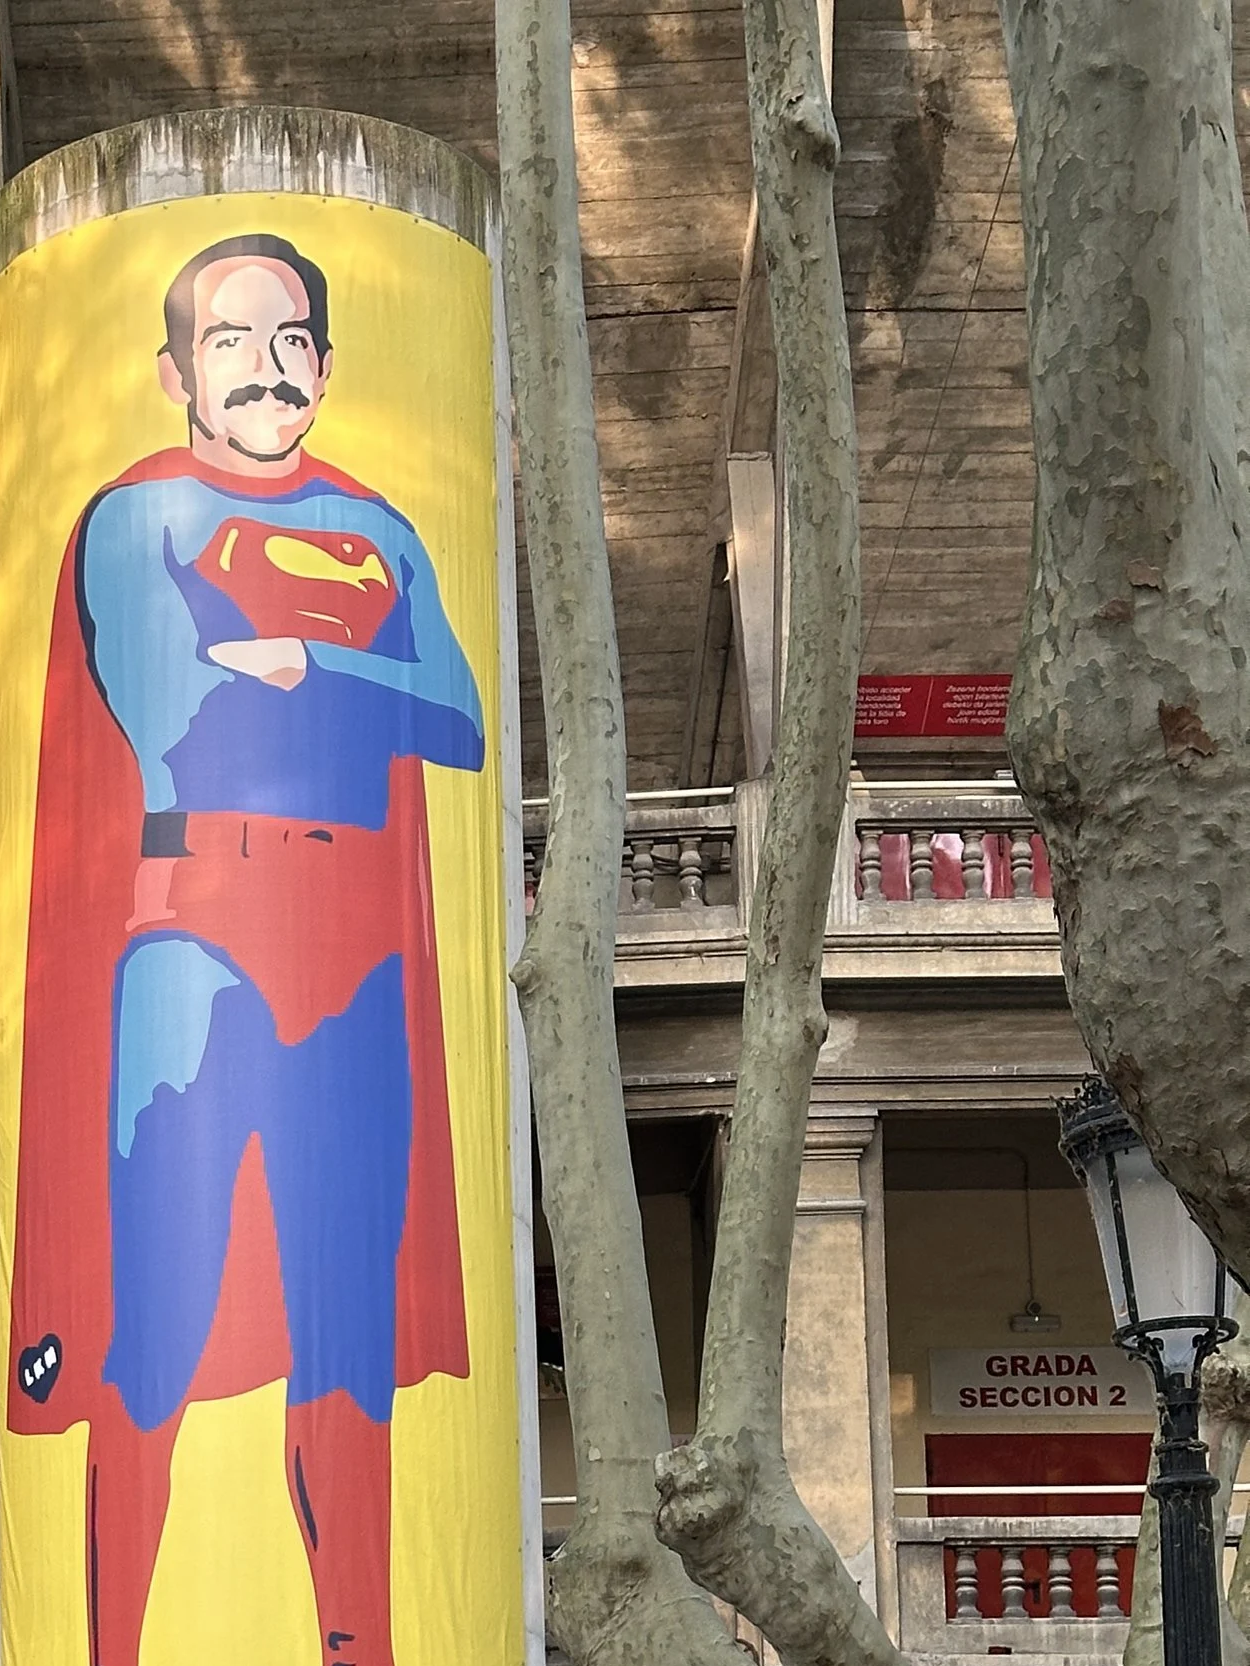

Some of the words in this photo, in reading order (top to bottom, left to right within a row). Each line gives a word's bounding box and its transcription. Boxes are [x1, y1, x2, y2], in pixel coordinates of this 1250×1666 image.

[985, 1353, 1098, 1377] GRADA
[959, 1385, 1099, 1408] SECCION
[1108, 1384, 1127, 1406] 2
